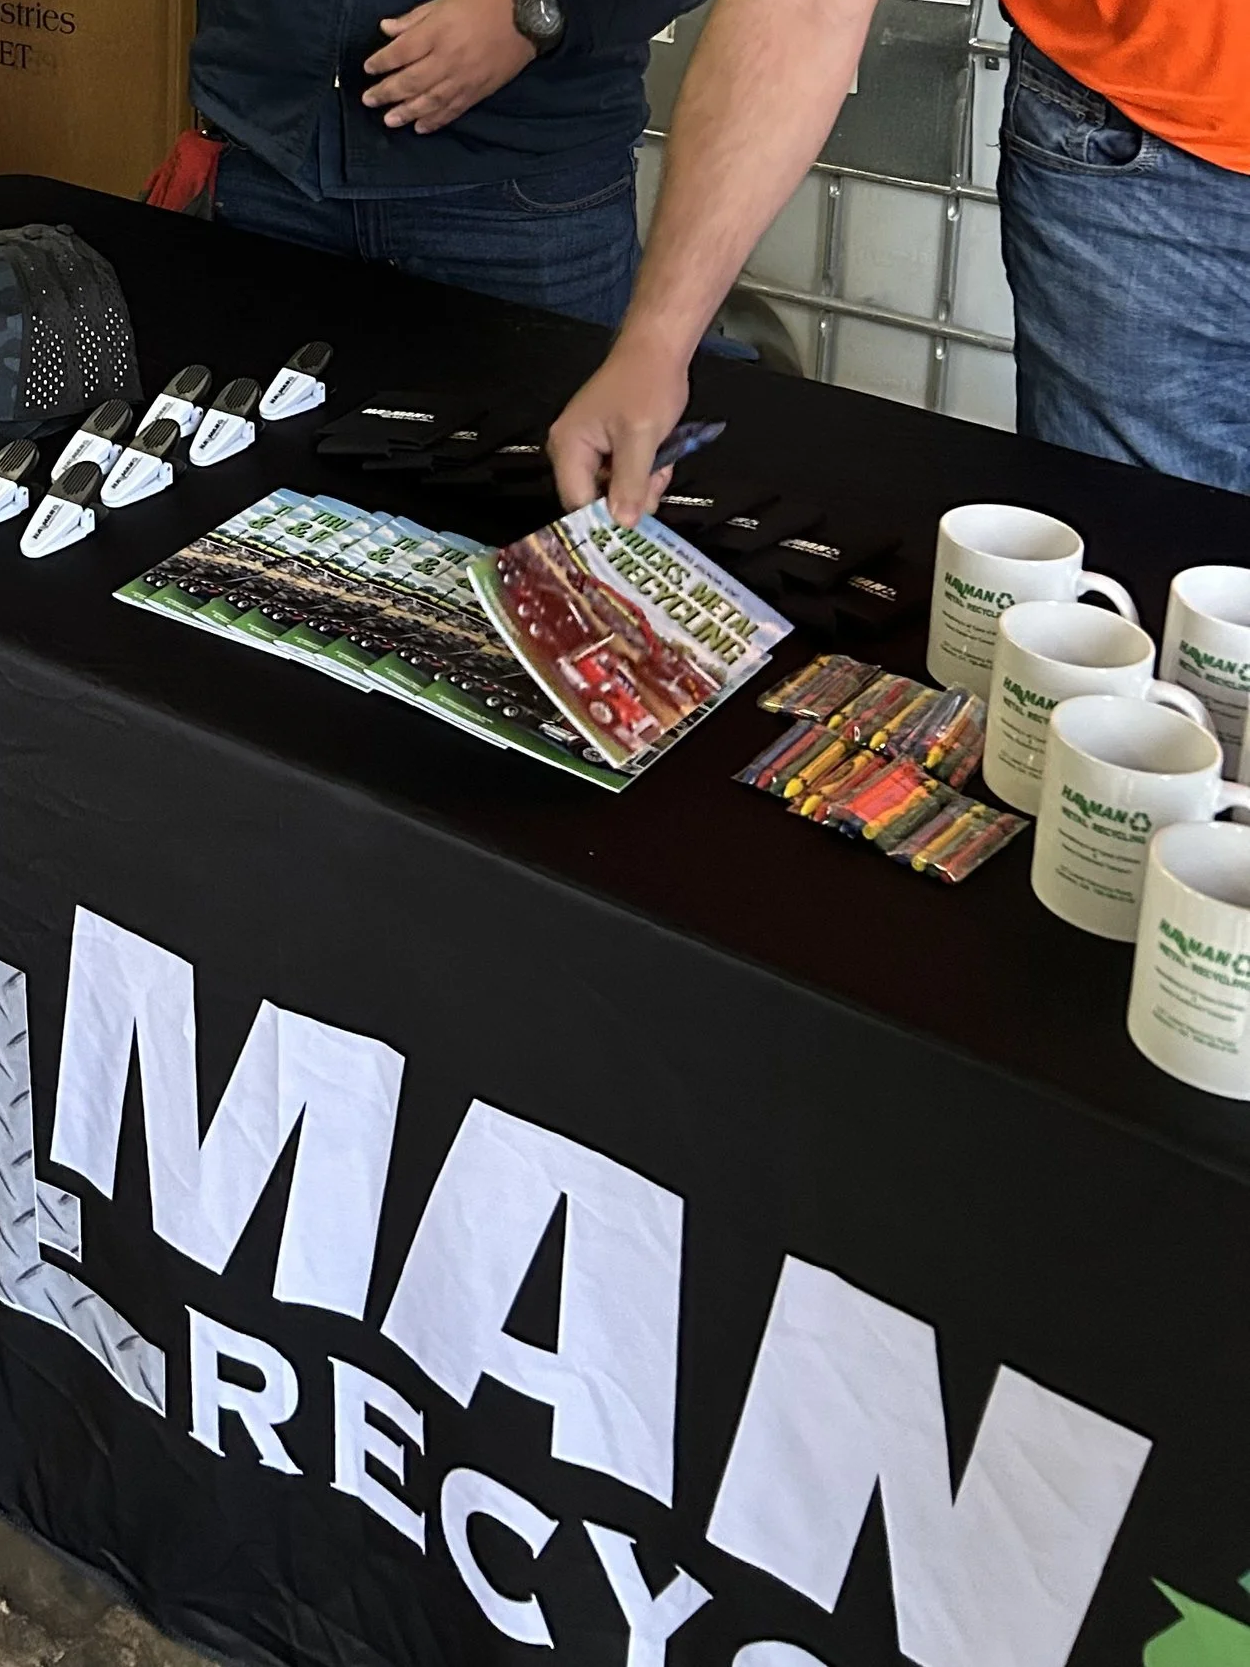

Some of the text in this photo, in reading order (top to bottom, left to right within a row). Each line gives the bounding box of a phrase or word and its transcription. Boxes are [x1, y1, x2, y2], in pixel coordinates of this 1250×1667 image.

[310, 509, 353, 532] TRU
[607, 546, 747, 667] RECYCLING
[688, 582, 760, 645] METAL
[184, 1304, 835, 1667] RECY
